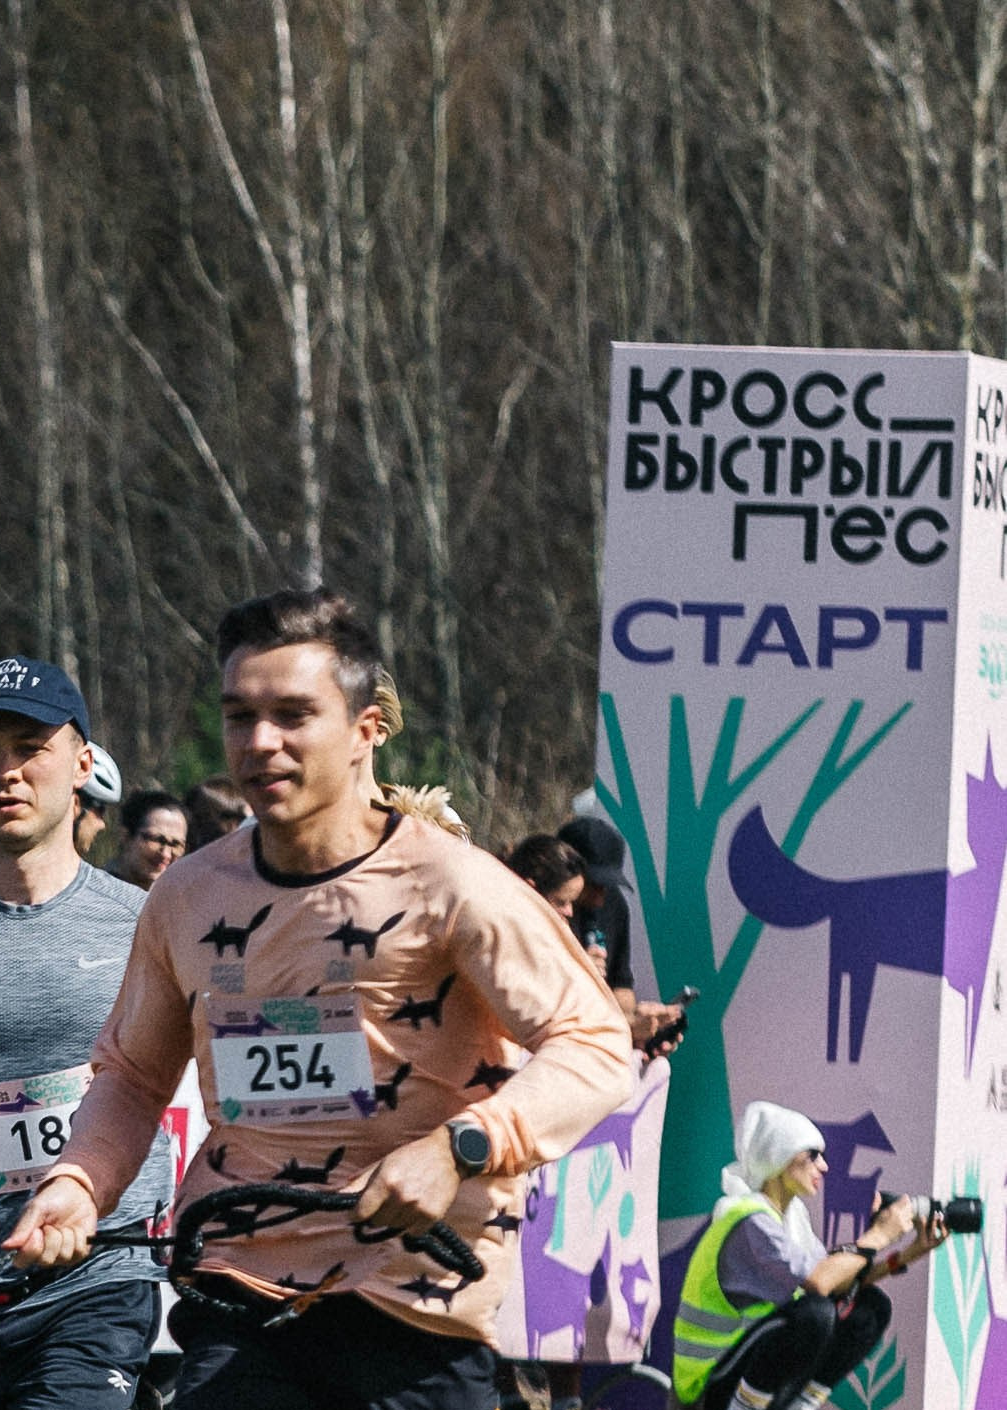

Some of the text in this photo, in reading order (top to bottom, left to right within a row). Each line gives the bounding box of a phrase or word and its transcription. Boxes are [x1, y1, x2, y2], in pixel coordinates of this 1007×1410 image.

[627, 366, 886, 431] КРОСС
[624, 417, 955, 499] БЫСТРЫЙ
[611, 600, 948, 672] СТАРТ
[246, 1043, 335, 1092] 254
[11, 1115, 73, 1161] 18
